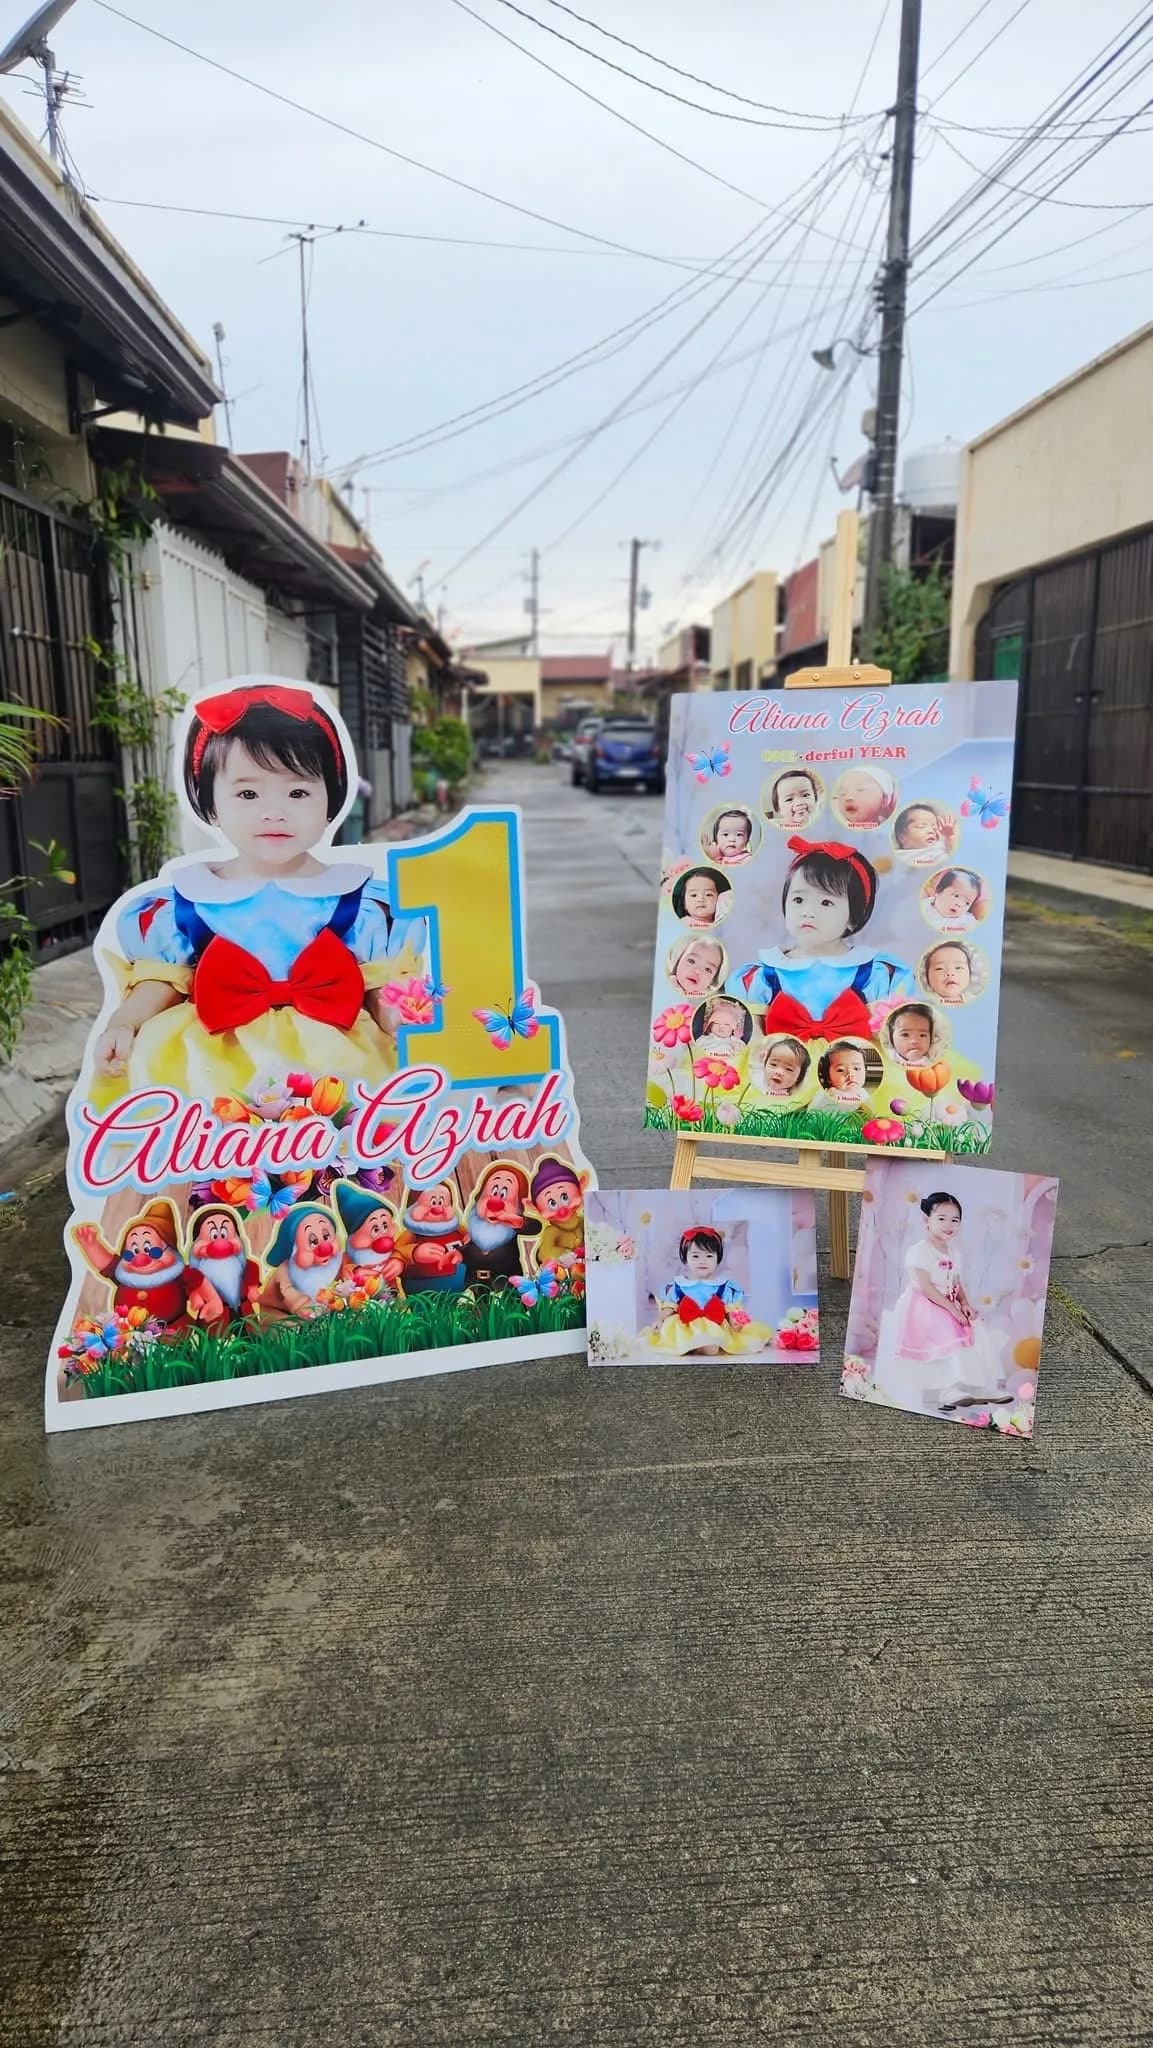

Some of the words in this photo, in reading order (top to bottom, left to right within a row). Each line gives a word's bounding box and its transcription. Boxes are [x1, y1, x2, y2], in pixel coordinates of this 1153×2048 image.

[729, 697, 829, 732] Aliana
[841, 693, 942, 739] Azrah
[860, 746, 907, 759] YEAR
[387, 811, 560, 1090] 1
[83, 1091, 335, 1186] Aliana
[352, 1068, 568, 1181] Azrah
